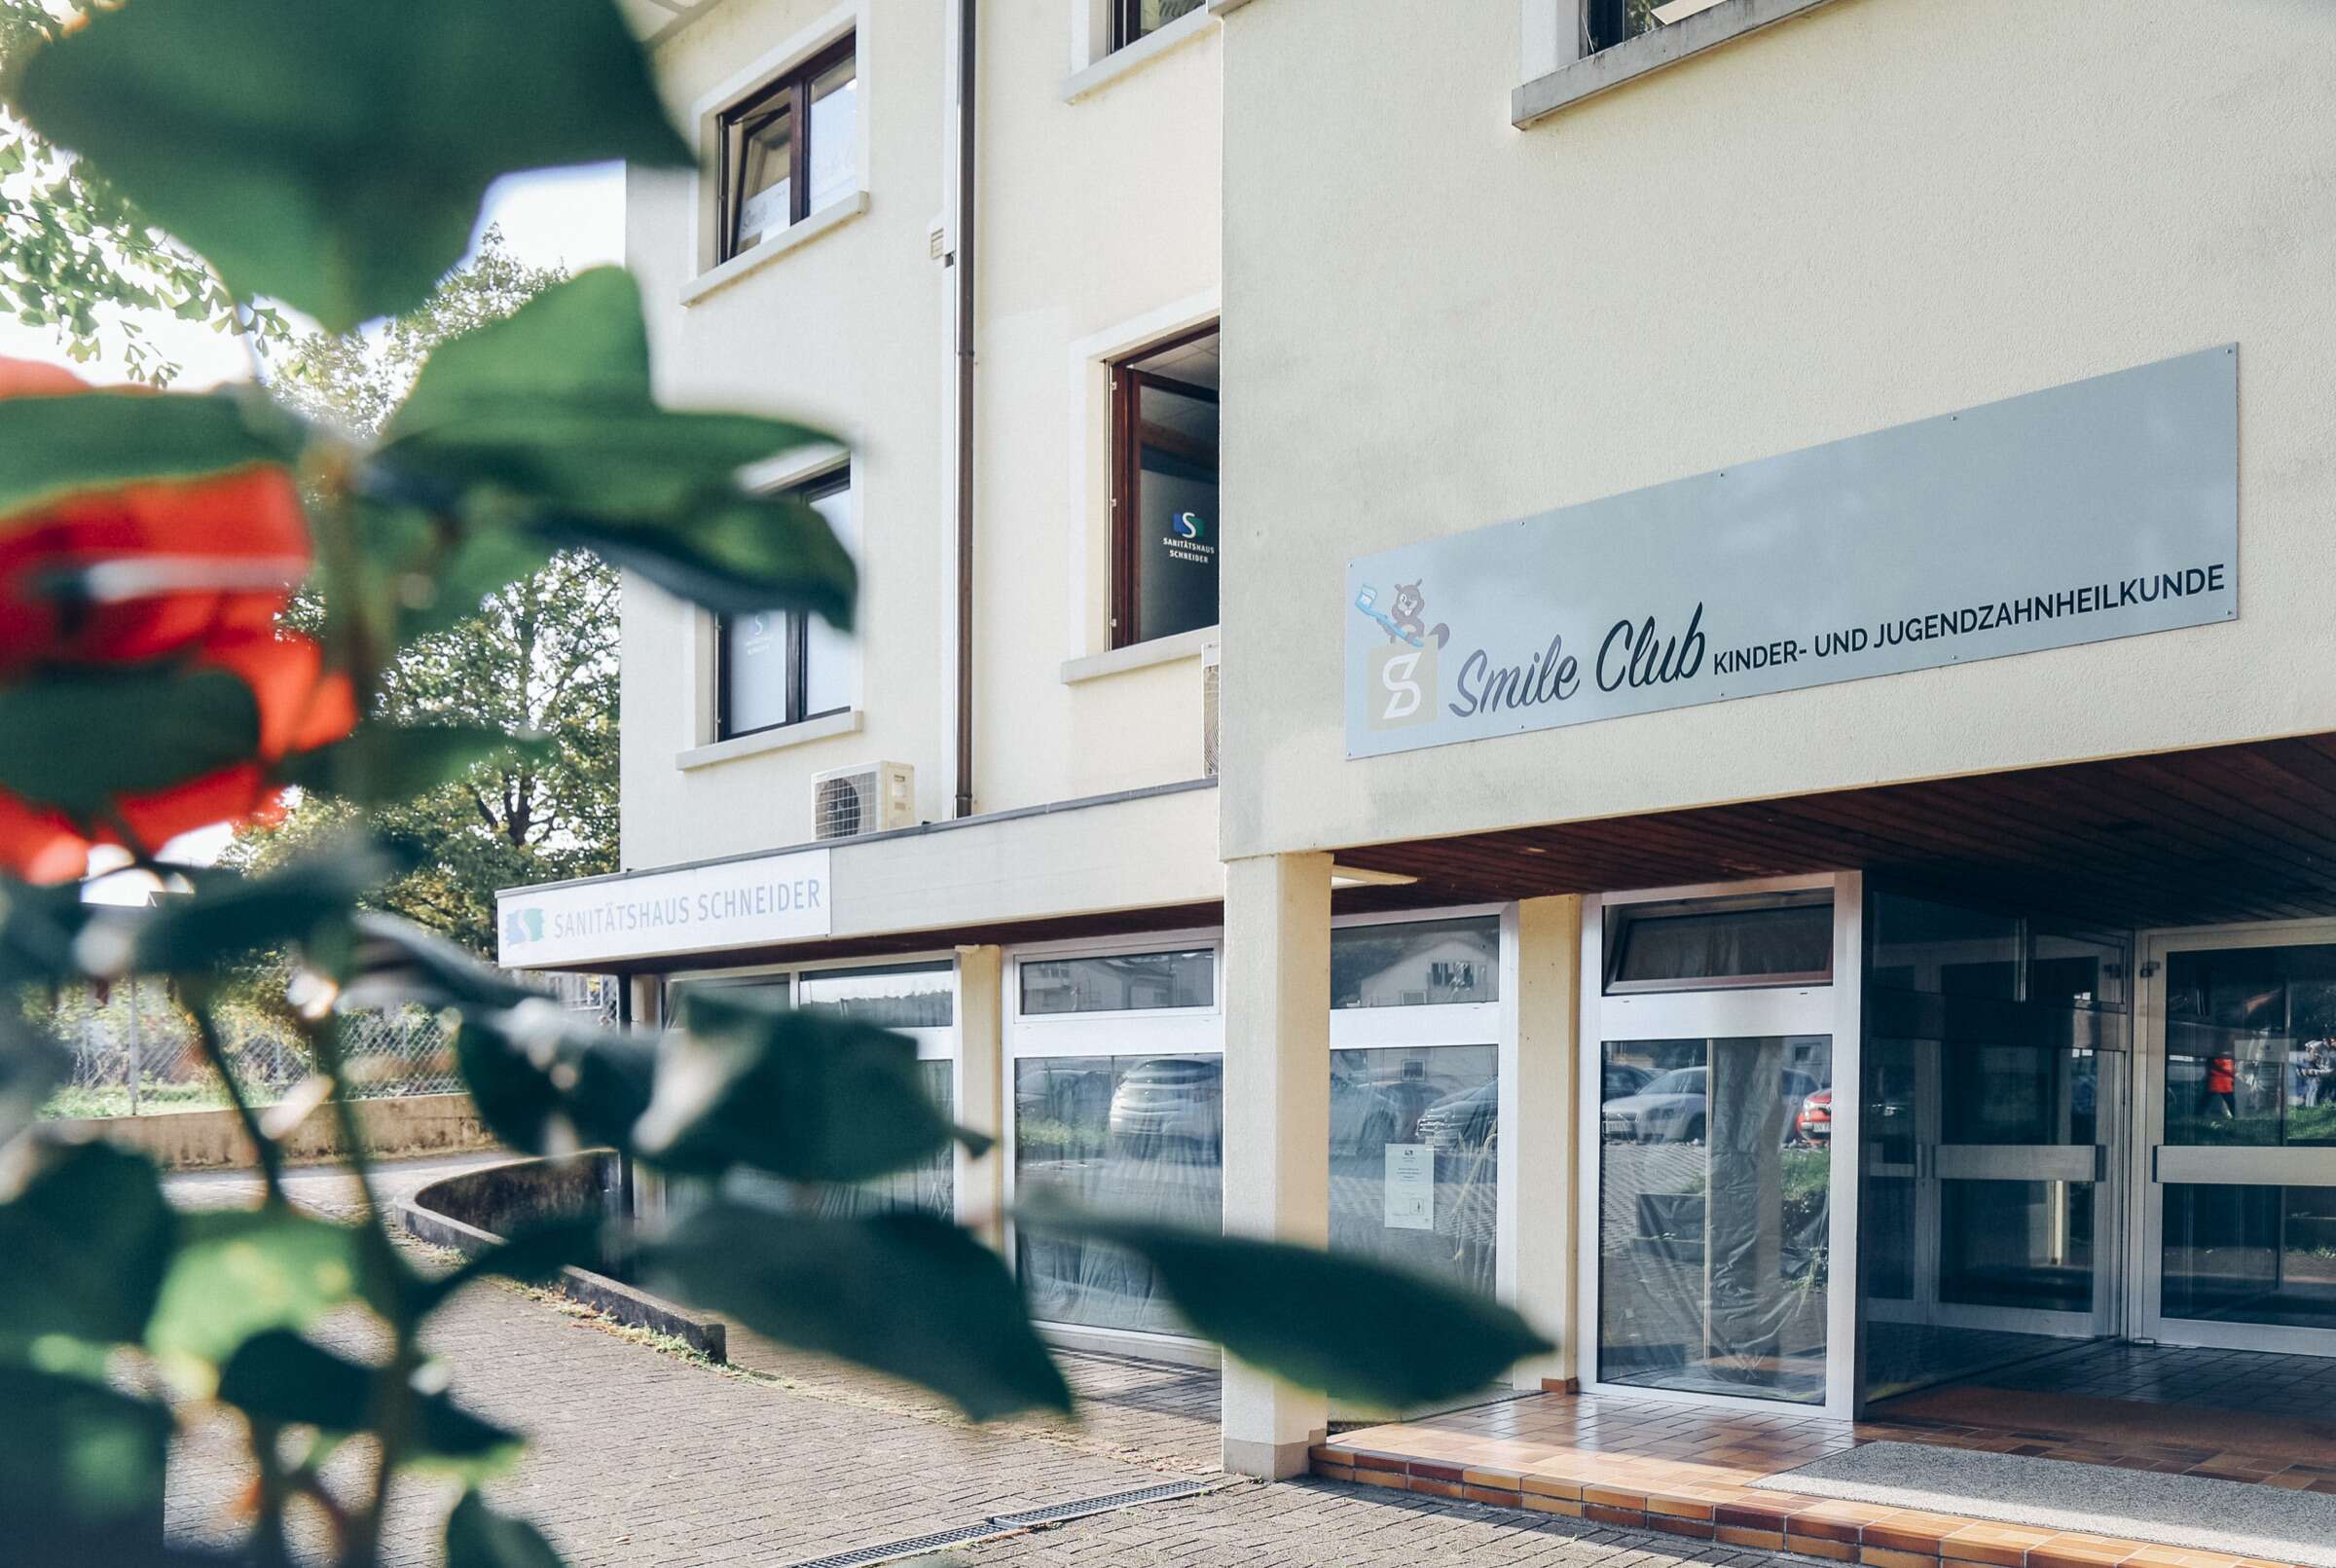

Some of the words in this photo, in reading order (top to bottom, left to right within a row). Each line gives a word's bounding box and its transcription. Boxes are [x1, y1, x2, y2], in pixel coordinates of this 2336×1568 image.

[1169, 550, 1208, 564] SCHNEIDER
[1448, 634, 1580, 717] Smile
[1596, 601, 1706, 692] Club
[1714, 641, 1807, 675] KINDER-
[1814, 628, 1869, 659] UND
[1873, 564, 2225, 649] JUGENDZAHNHEILKUNDE
[554, 896, 690, 939] SANITÄTSHAUS
[698, 879, 821, 922] SCHNEIDER
